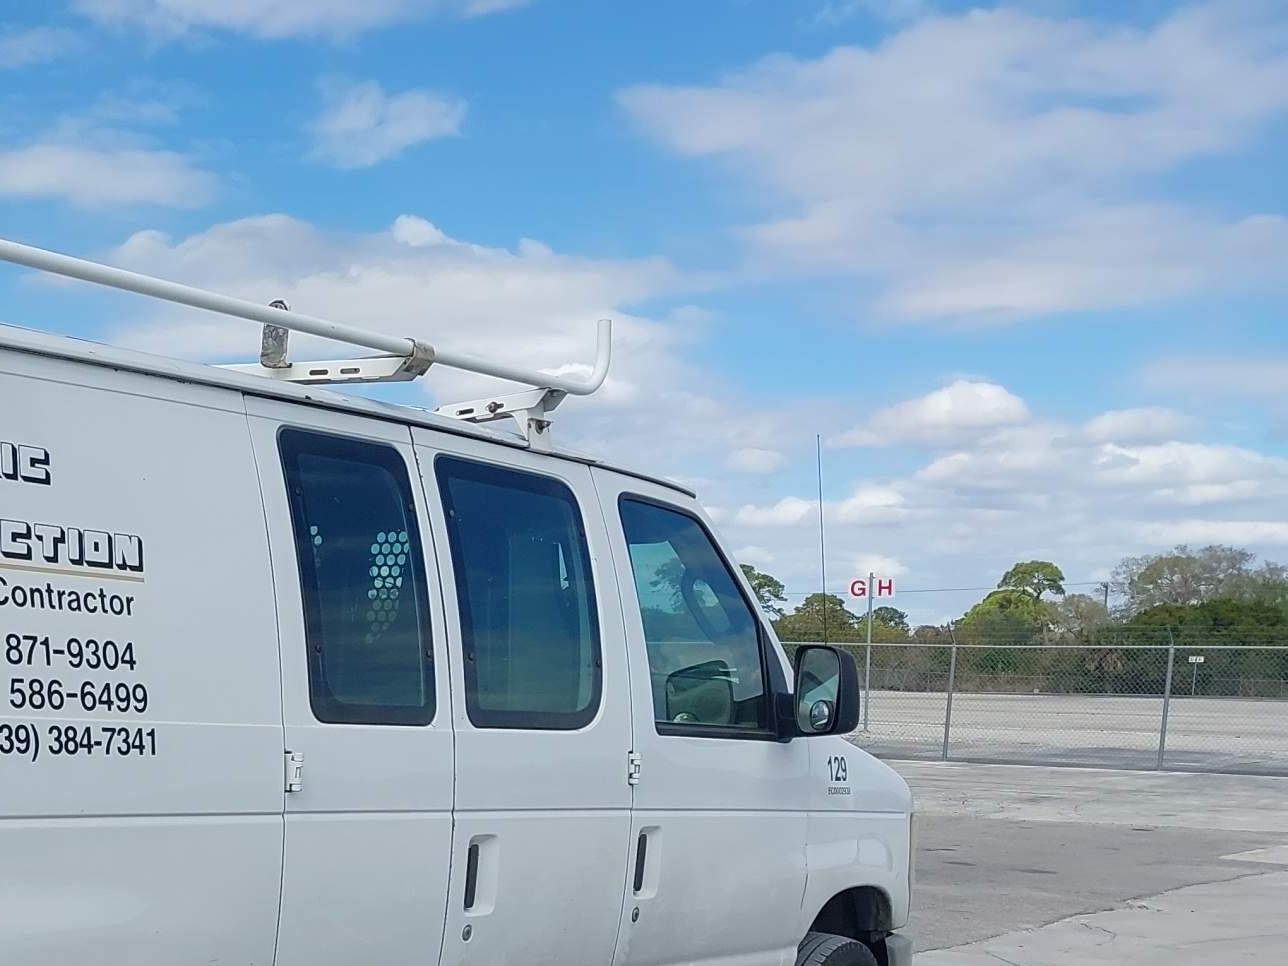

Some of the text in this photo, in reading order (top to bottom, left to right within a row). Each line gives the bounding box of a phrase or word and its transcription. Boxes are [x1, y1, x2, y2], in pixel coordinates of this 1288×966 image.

[851, 579, 892, 597] G H
[5, 633, 137, 671] 871-9304
[9, 678, 148, 714] 586-6499
[48, 726, 157, 757] 384-7341
[827, 755, 848, 782] 129
